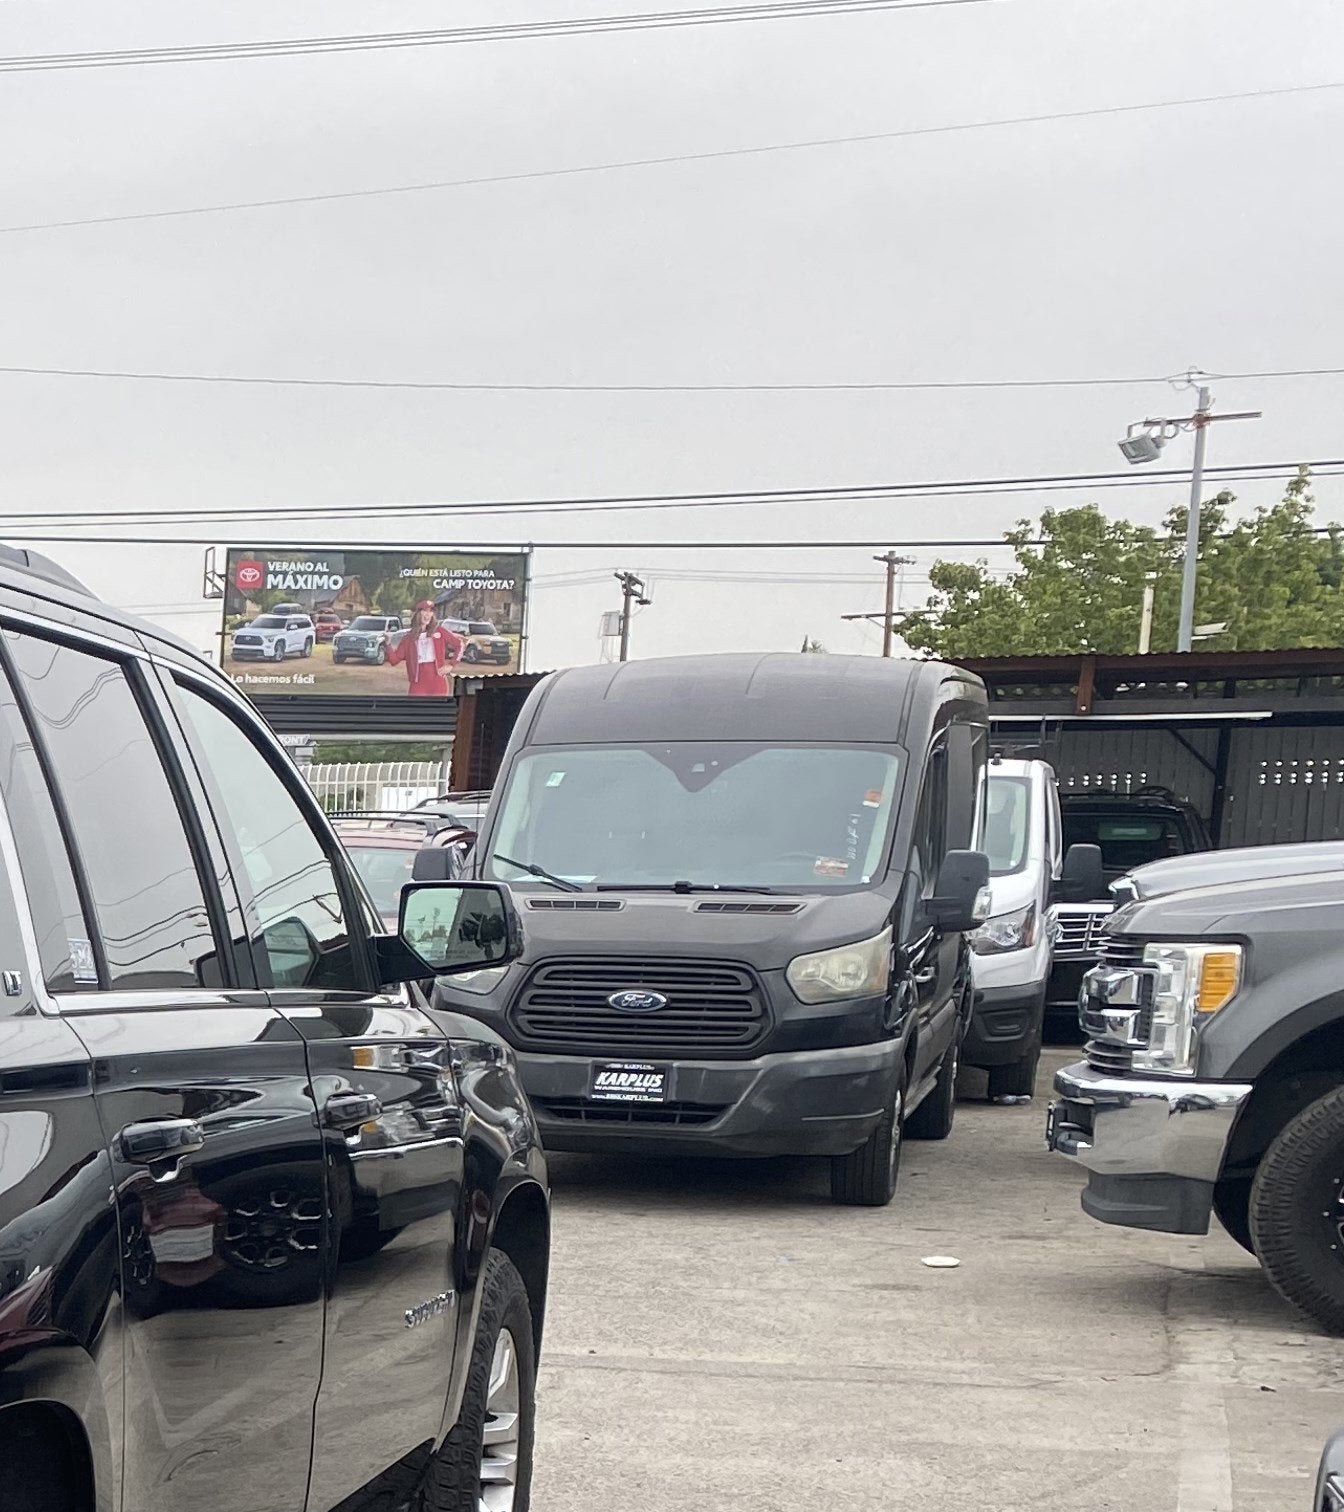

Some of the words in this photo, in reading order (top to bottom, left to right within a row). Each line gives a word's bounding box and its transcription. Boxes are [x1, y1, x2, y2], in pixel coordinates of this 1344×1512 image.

[267, 561, 313, 572] VERANO
[314, 562, 330, 573] AL
[449, 569, 472, 577] LISTO
[473, 569, 495, 578] PARA
[266, 571, 344, 590] MÁXIMO
[433, 579, 466, 589] CAMP
[467, 579, 515, 590] TOYOTA?
[245, 673, 291, 684] hacemos
[292, 673, 315, 684] fácil
[621, 993, 653, 1007] Ford
[595, 1072, 664, 1087] KARPLUS
